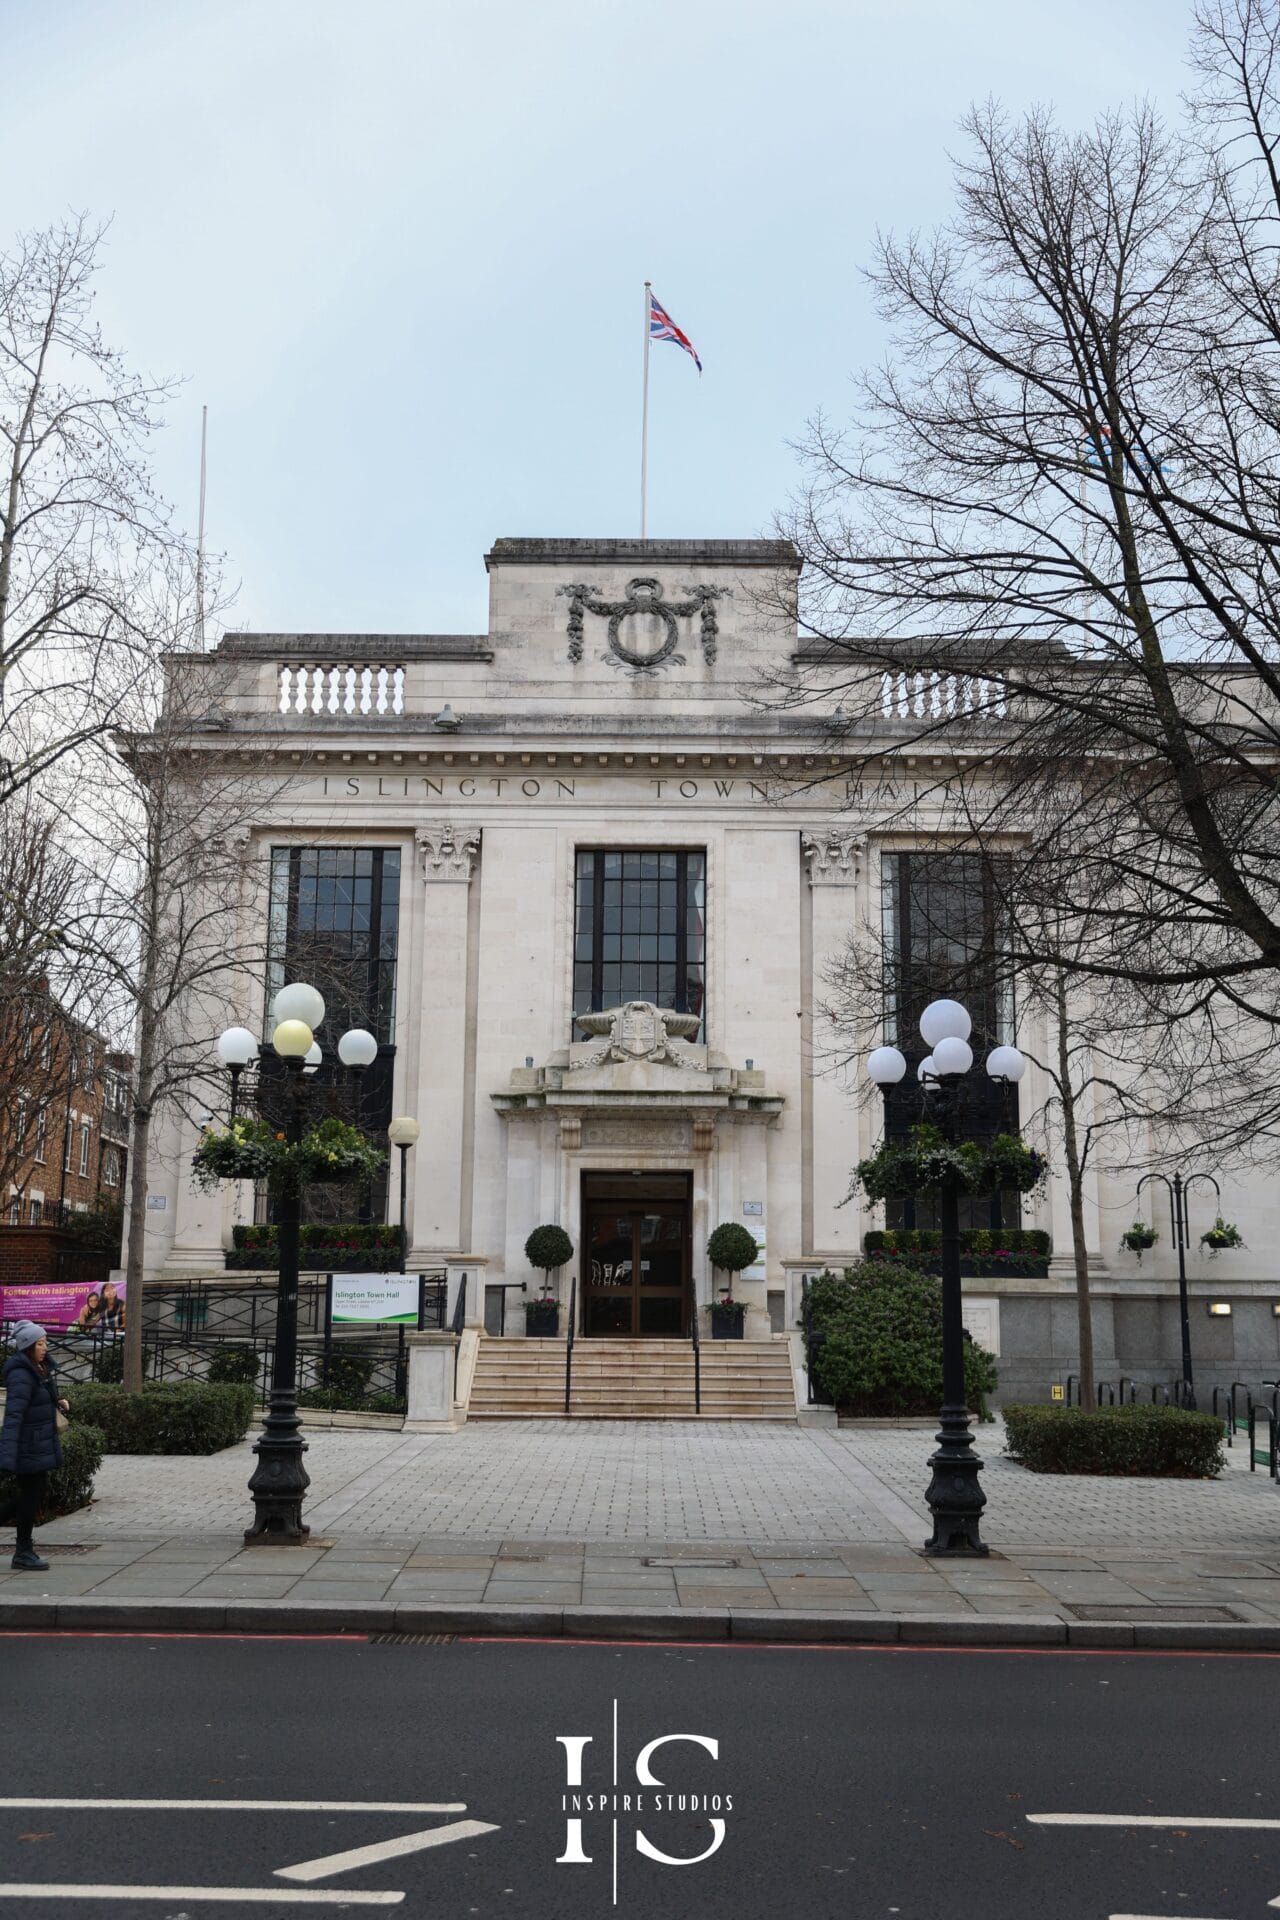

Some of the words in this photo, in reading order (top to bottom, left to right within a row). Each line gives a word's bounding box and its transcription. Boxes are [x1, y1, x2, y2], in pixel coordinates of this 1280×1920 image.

[323, 777, 576, 798] ISLINGTON
[650, 780, 769, 799] TOWN
[845, 781, 961, 801] HALL
[3, 1288, 30, 1296] Foster
[32, 1287, 51, 1295] with
[52, 1286, 90, 1296] Islington
[335, 1291, 365, 1299] Islington
